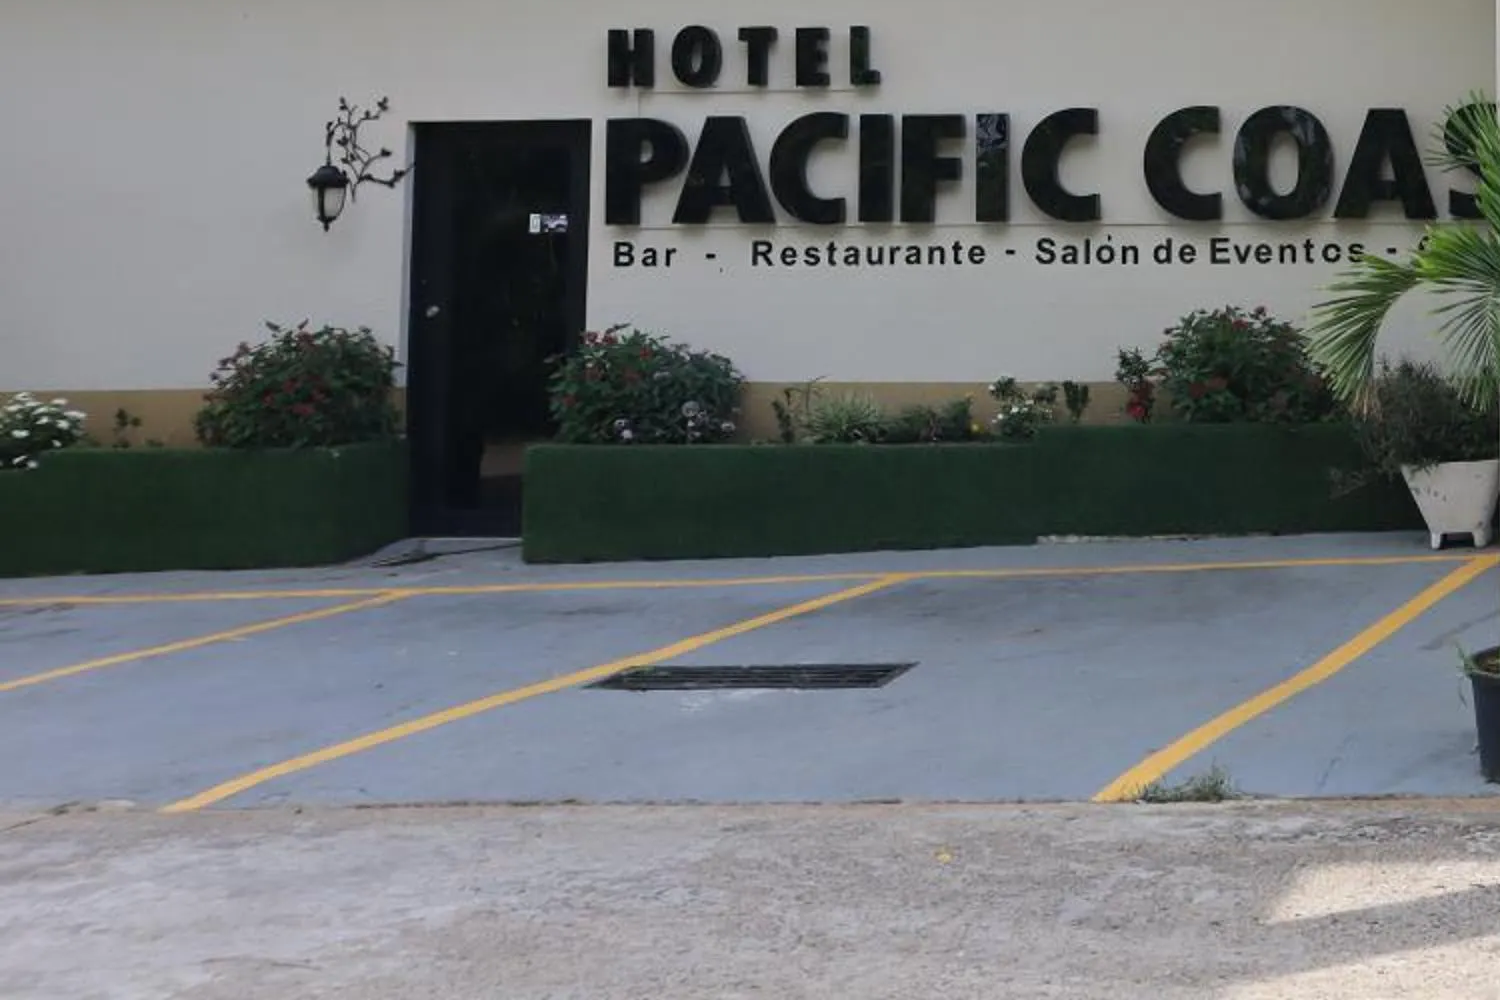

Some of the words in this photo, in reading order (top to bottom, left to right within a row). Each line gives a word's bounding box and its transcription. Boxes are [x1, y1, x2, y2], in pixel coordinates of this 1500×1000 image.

[607, 25, 882, 89] HOTEL
[605, 107, 1102, 224] PACIFIC
[613, 241, 677, 268] Bar
[751, 239, 986, 267] Restaurante
[1035, 233, 1139, 265] Salón
[1153, 237, 1197, 265] de
[1208, 236, 1365, 265] Eventos
